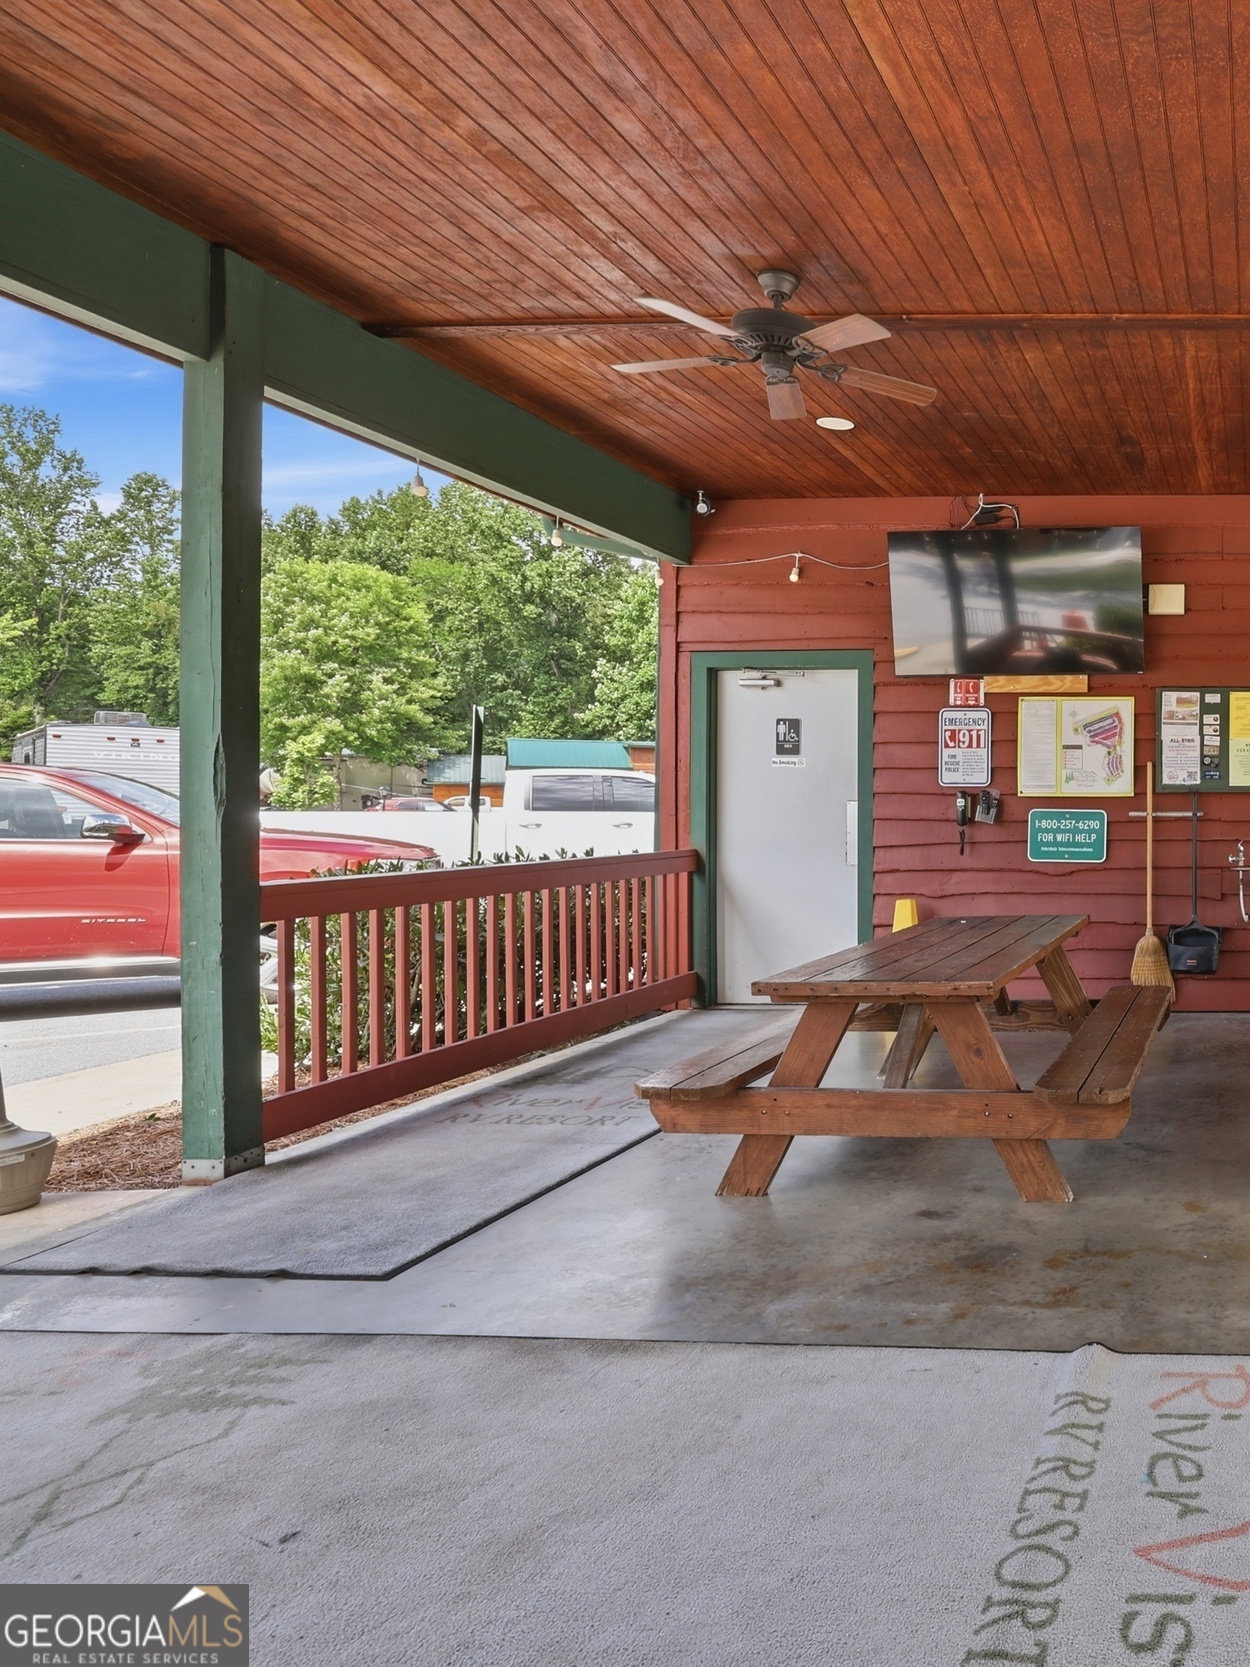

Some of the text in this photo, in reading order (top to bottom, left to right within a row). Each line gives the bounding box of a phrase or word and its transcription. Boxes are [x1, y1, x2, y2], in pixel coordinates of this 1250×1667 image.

[944, 718, 986, 726] EMERGENCY
[958, 730, 985, 748] 911
[1035, 820, 1100, 829] 1-800-257-6290
[1038, 833, 1096, 842] FOR WIFI HELP
